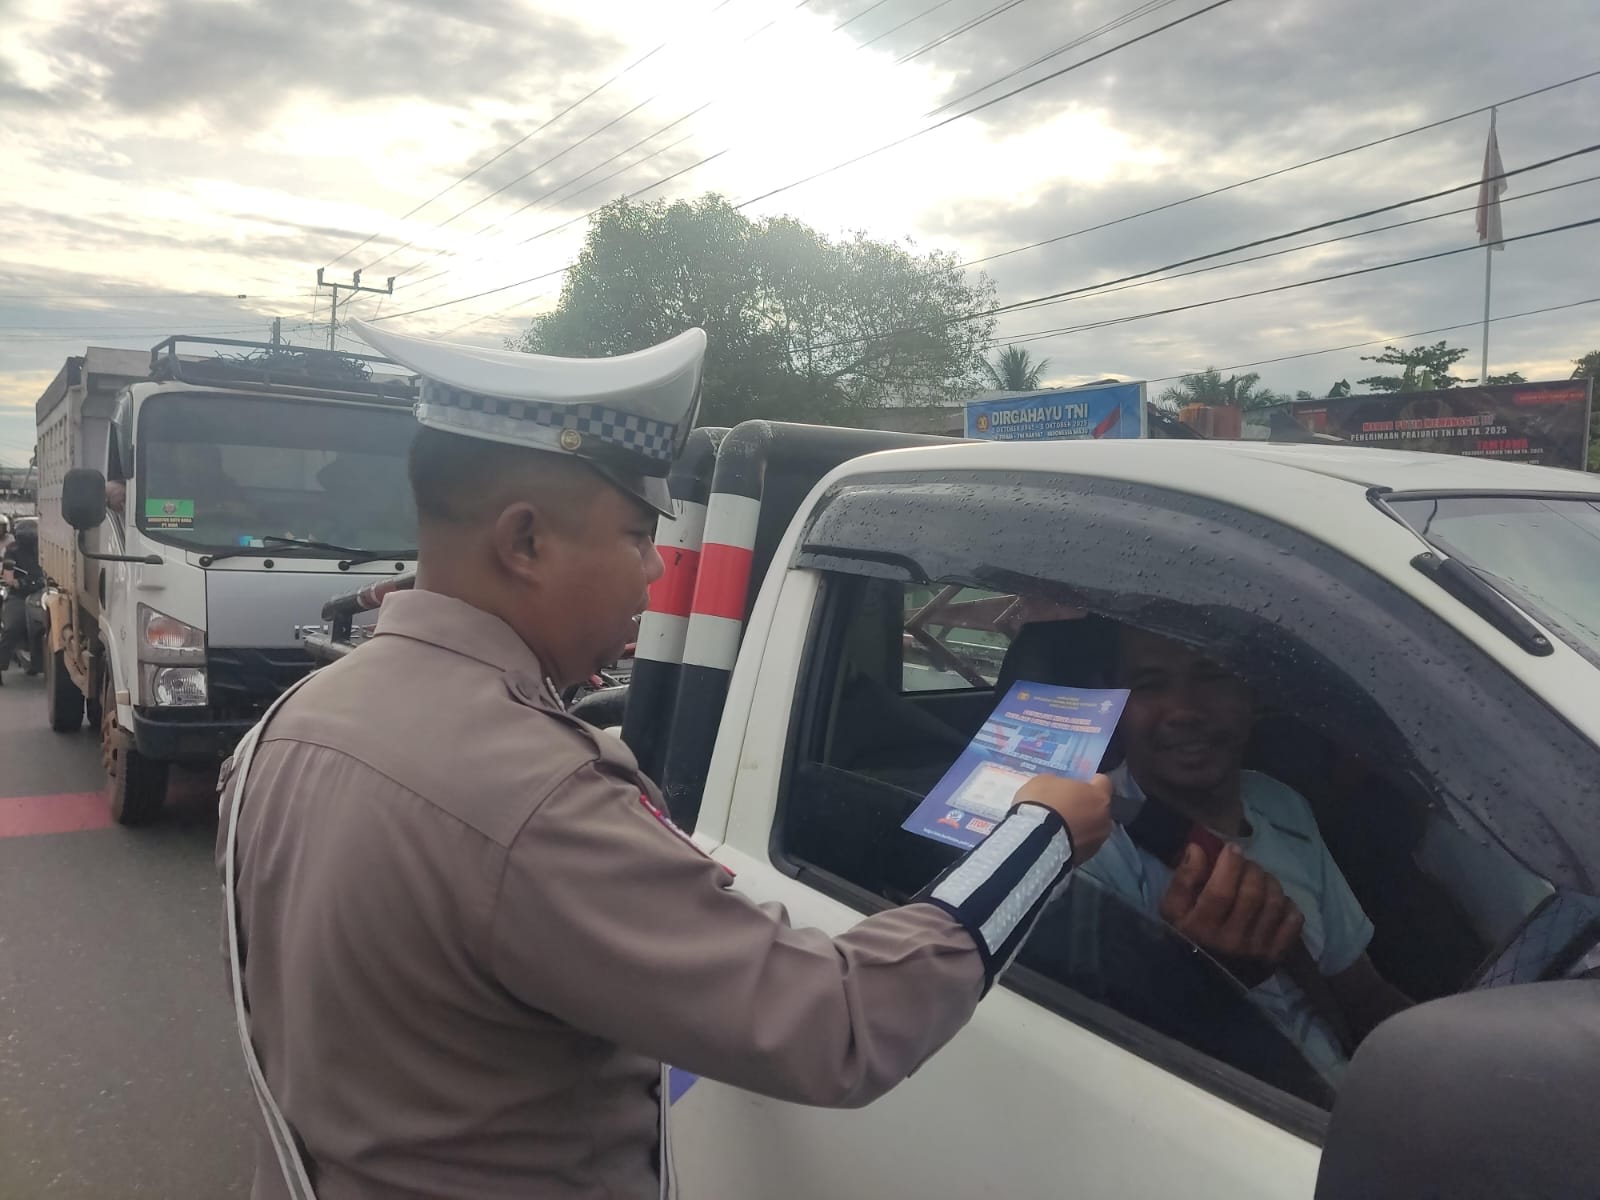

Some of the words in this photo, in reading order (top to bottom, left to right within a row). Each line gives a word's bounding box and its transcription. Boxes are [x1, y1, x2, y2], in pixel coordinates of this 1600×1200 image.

[992, 405, 1062, 426] DIRGAHAYU
[1065, 403, 1088, 419] TNI
[1485, 425, 1507, 435] 2025
